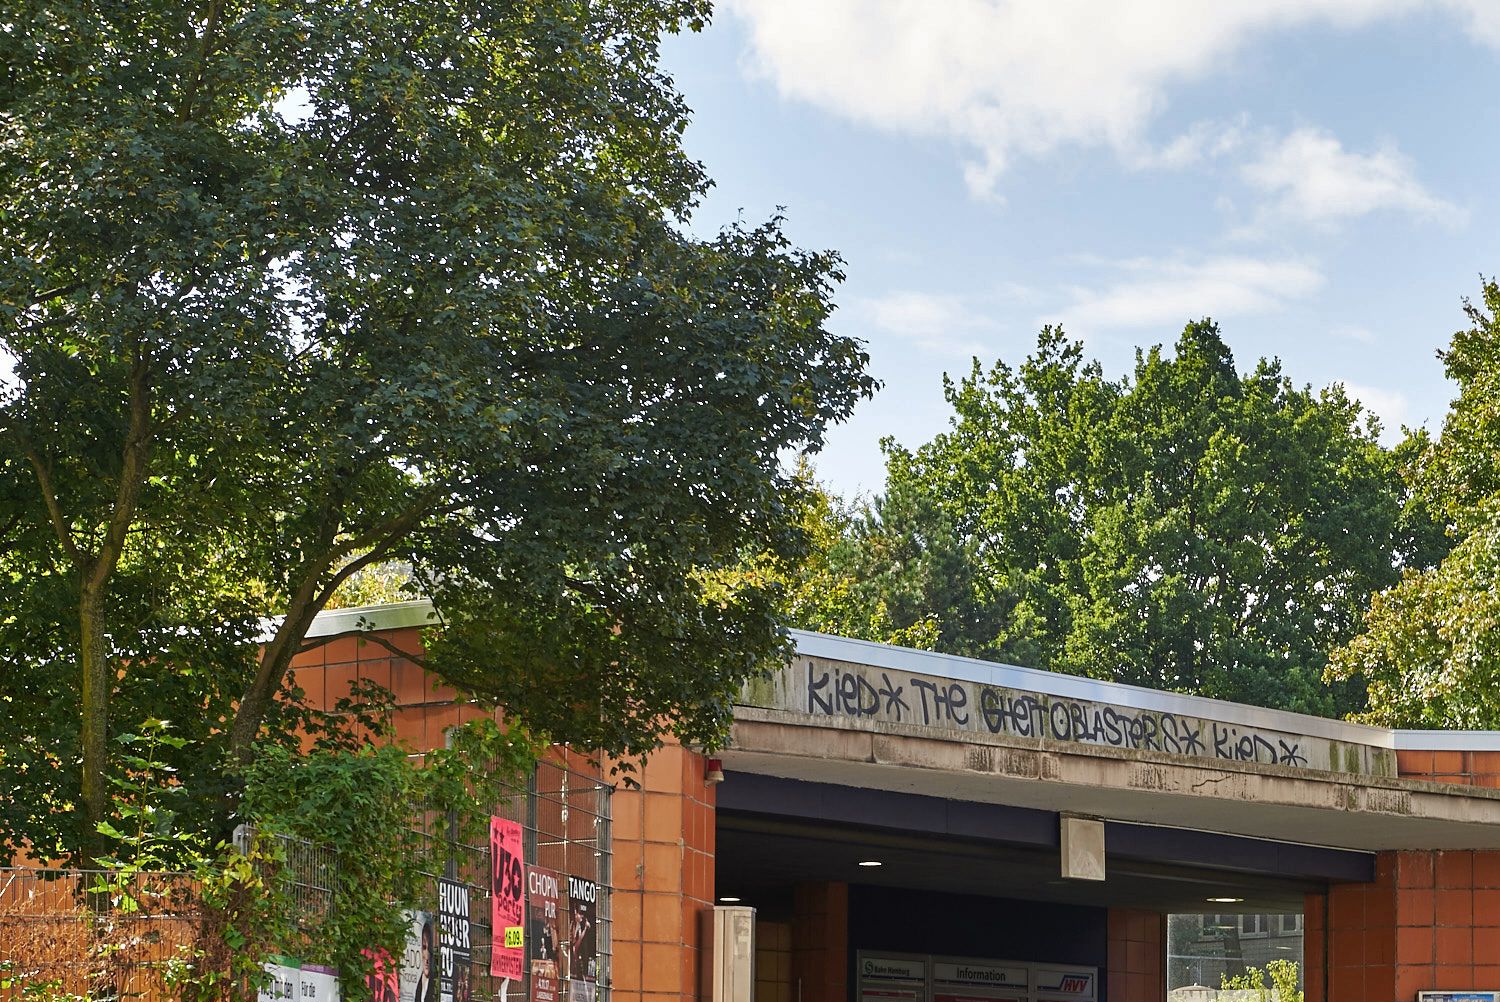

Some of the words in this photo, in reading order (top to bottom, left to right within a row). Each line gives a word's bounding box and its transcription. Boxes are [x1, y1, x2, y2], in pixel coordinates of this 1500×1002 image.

[529, 871, 559, 900] CHOPIN
[568, 877, 596, 904] TANGO
[439, 882, 469, 918] HUUN
[440, 947, 453, 978] TU
[956, 967, 1006, 982] Information
[1063, 979, 1087, 992] HVV
